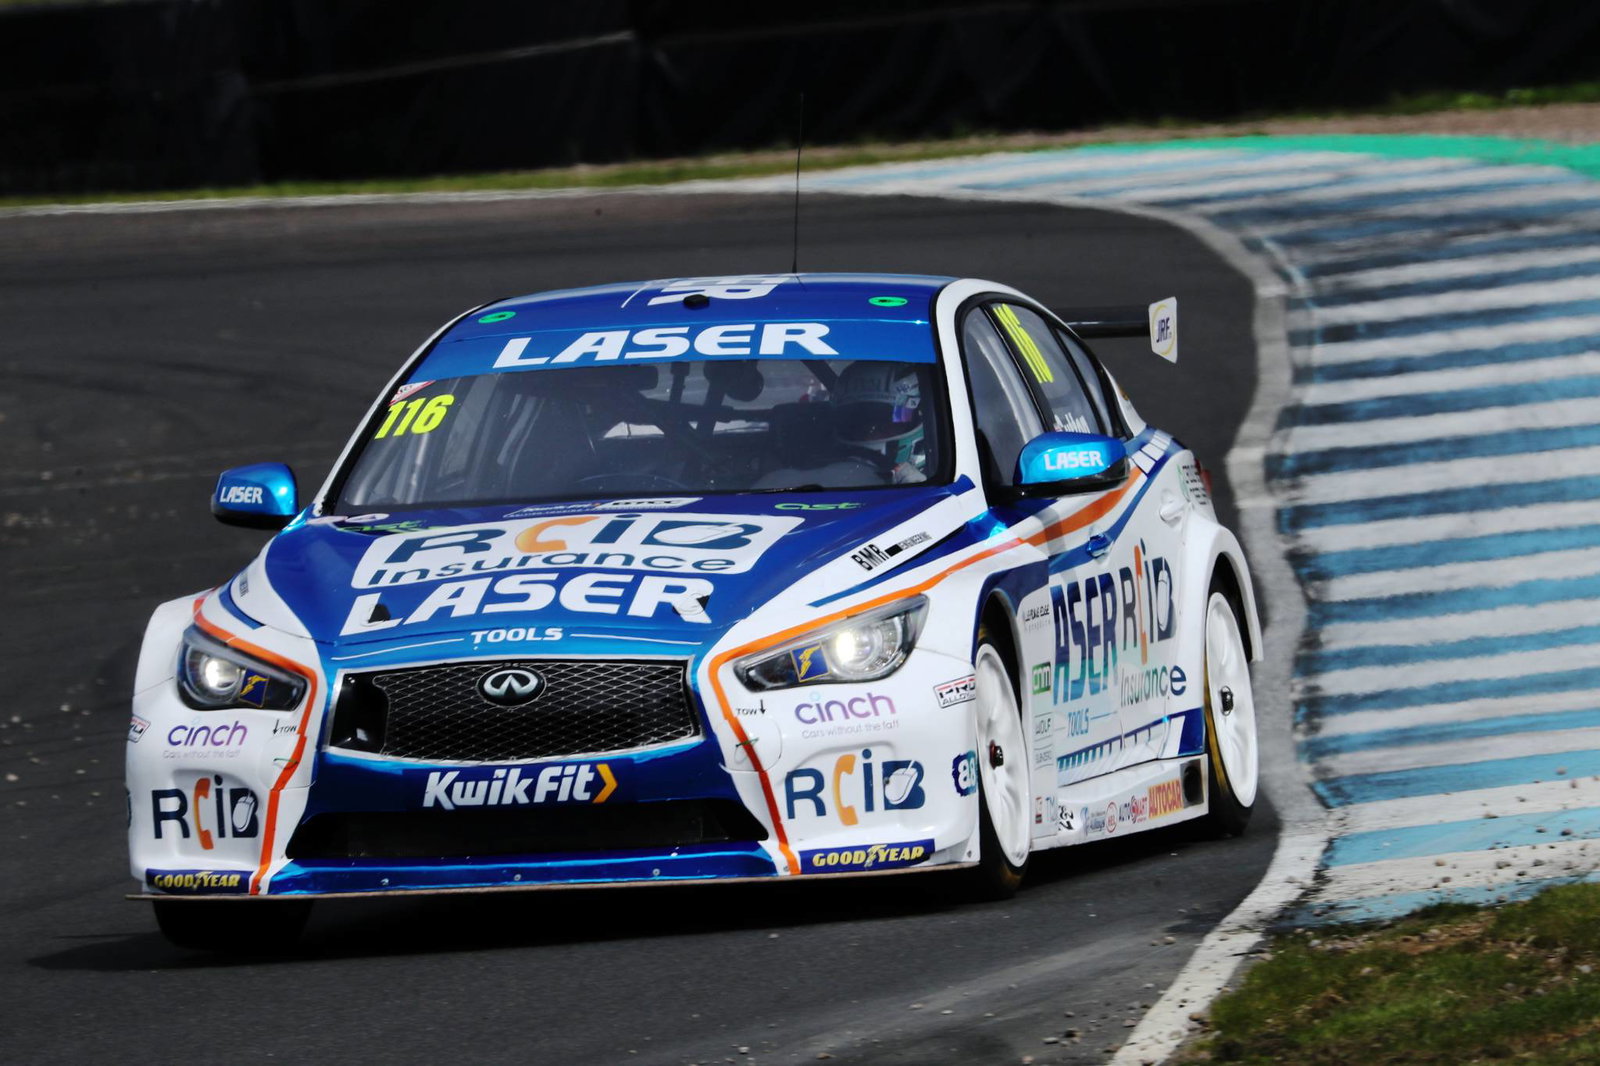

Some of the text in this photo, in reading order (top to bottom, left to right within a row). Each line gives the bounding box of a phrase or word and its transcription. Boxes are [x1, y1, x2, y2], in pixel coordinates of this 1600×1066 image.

[492, 322, 839, 369] LASER
[375, 394, 454, 439] 116
[1043, 450, 1104, 470] LASER
[219, 486, 263, 504] LASER
[368, 552, 735, 586] Insurance
[851, 543, 890, 571] BMR
[339, 573, 714, 636] LASER
[471, 628, 563, 643] TOOLS
[1120, 665, 1186, 708] Insurance
[736, 707, 757, 716] TOW
[794, 691, 896, 725] cinch
[167, 719, 248, 747] cinch
[279, 724, 297, 734] TOW
[1068, 708, 1090, 739] TOOLS
[1148, 779, 1182, 817] AUTOCAR
[812, 844, 925, 868] GOODYEAR
[154, 871, 242, 889] GOODYEAR
